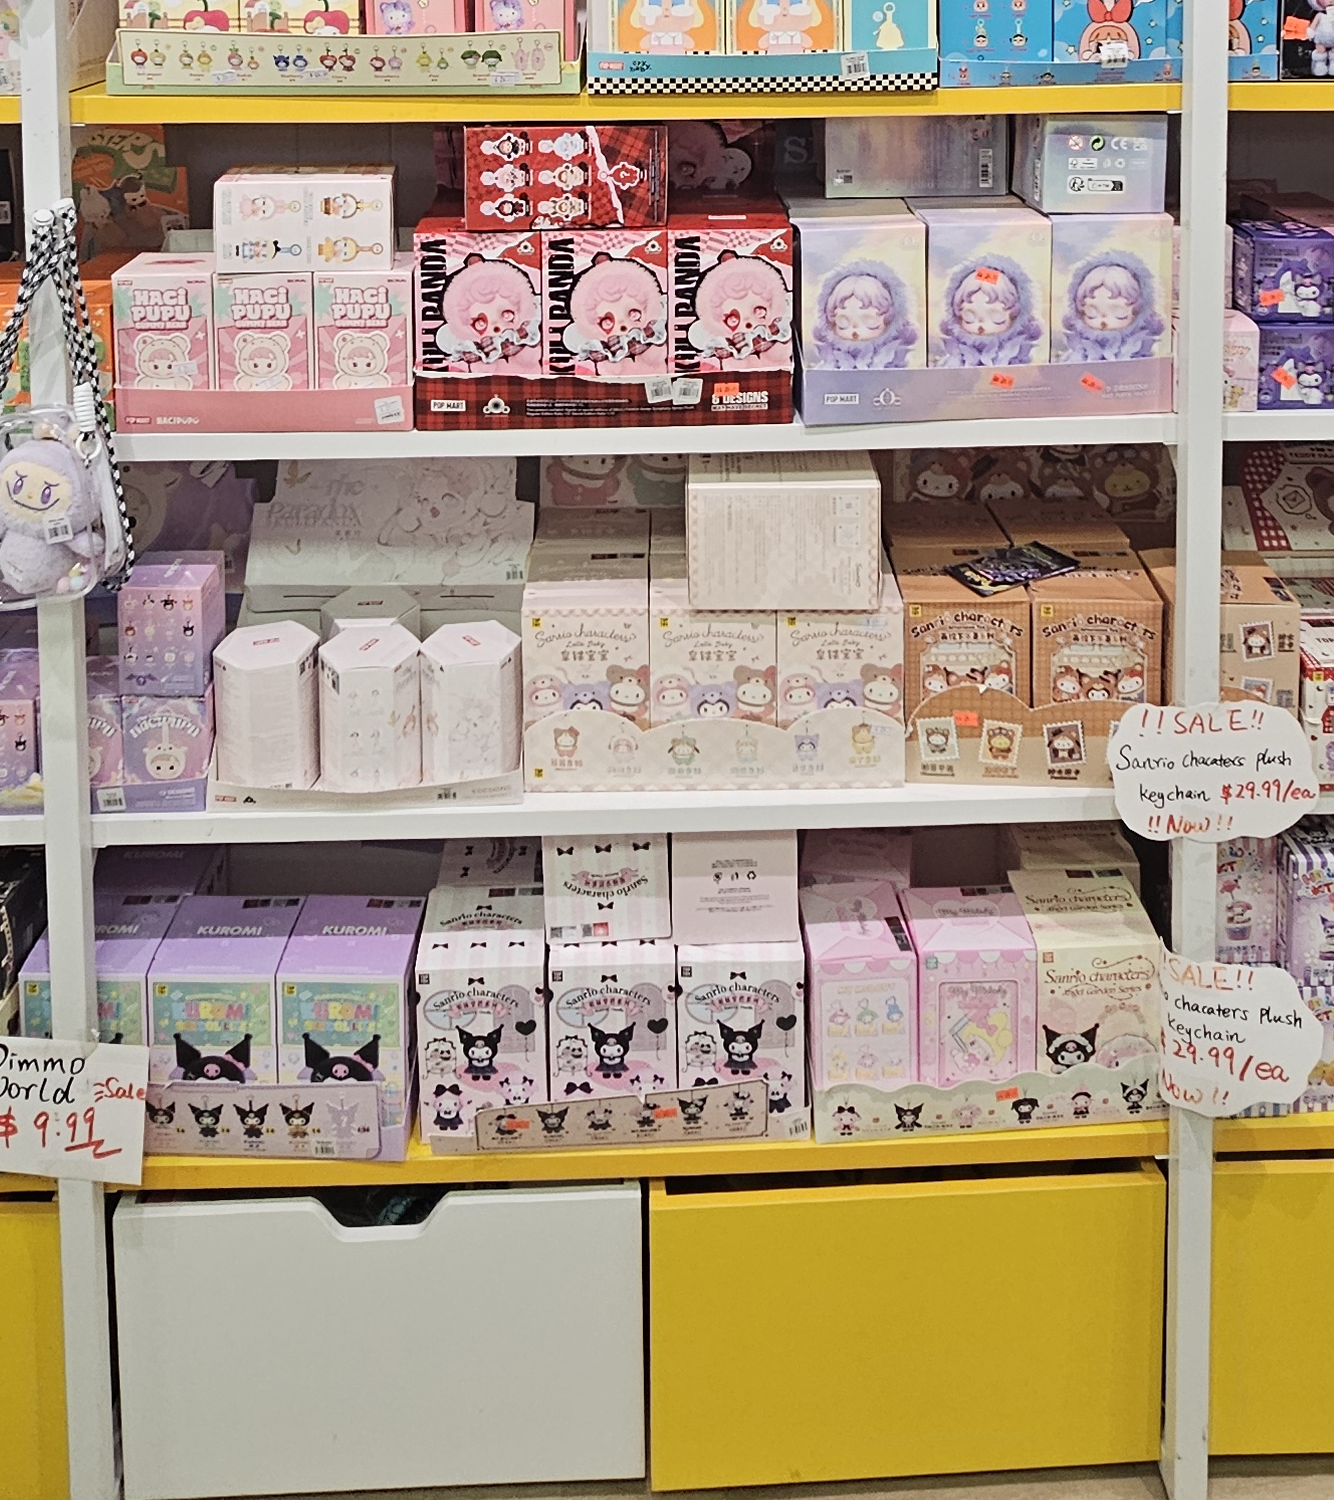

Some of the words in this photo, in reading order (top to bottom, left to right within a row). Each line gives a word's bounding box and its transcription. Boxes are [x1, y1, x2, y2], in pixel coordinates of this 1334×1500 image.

[130, 304, 191, 324] PUPU
[230, 304, 291, 323] PUPU
[535, 630, 571, 648] Sanrio
[573, 622, 637, 646] characters
[1115, 743, 1175, 774] Sanrio
[1256, 750, 1294, 777] plush
[1219, 778, 1317, 806] $29.99/ea
[196, 925, 263, 936] KUROMI
[1257, 999, 1305, 1028] Plush
[104, 1076, 146, 1101] Sale
